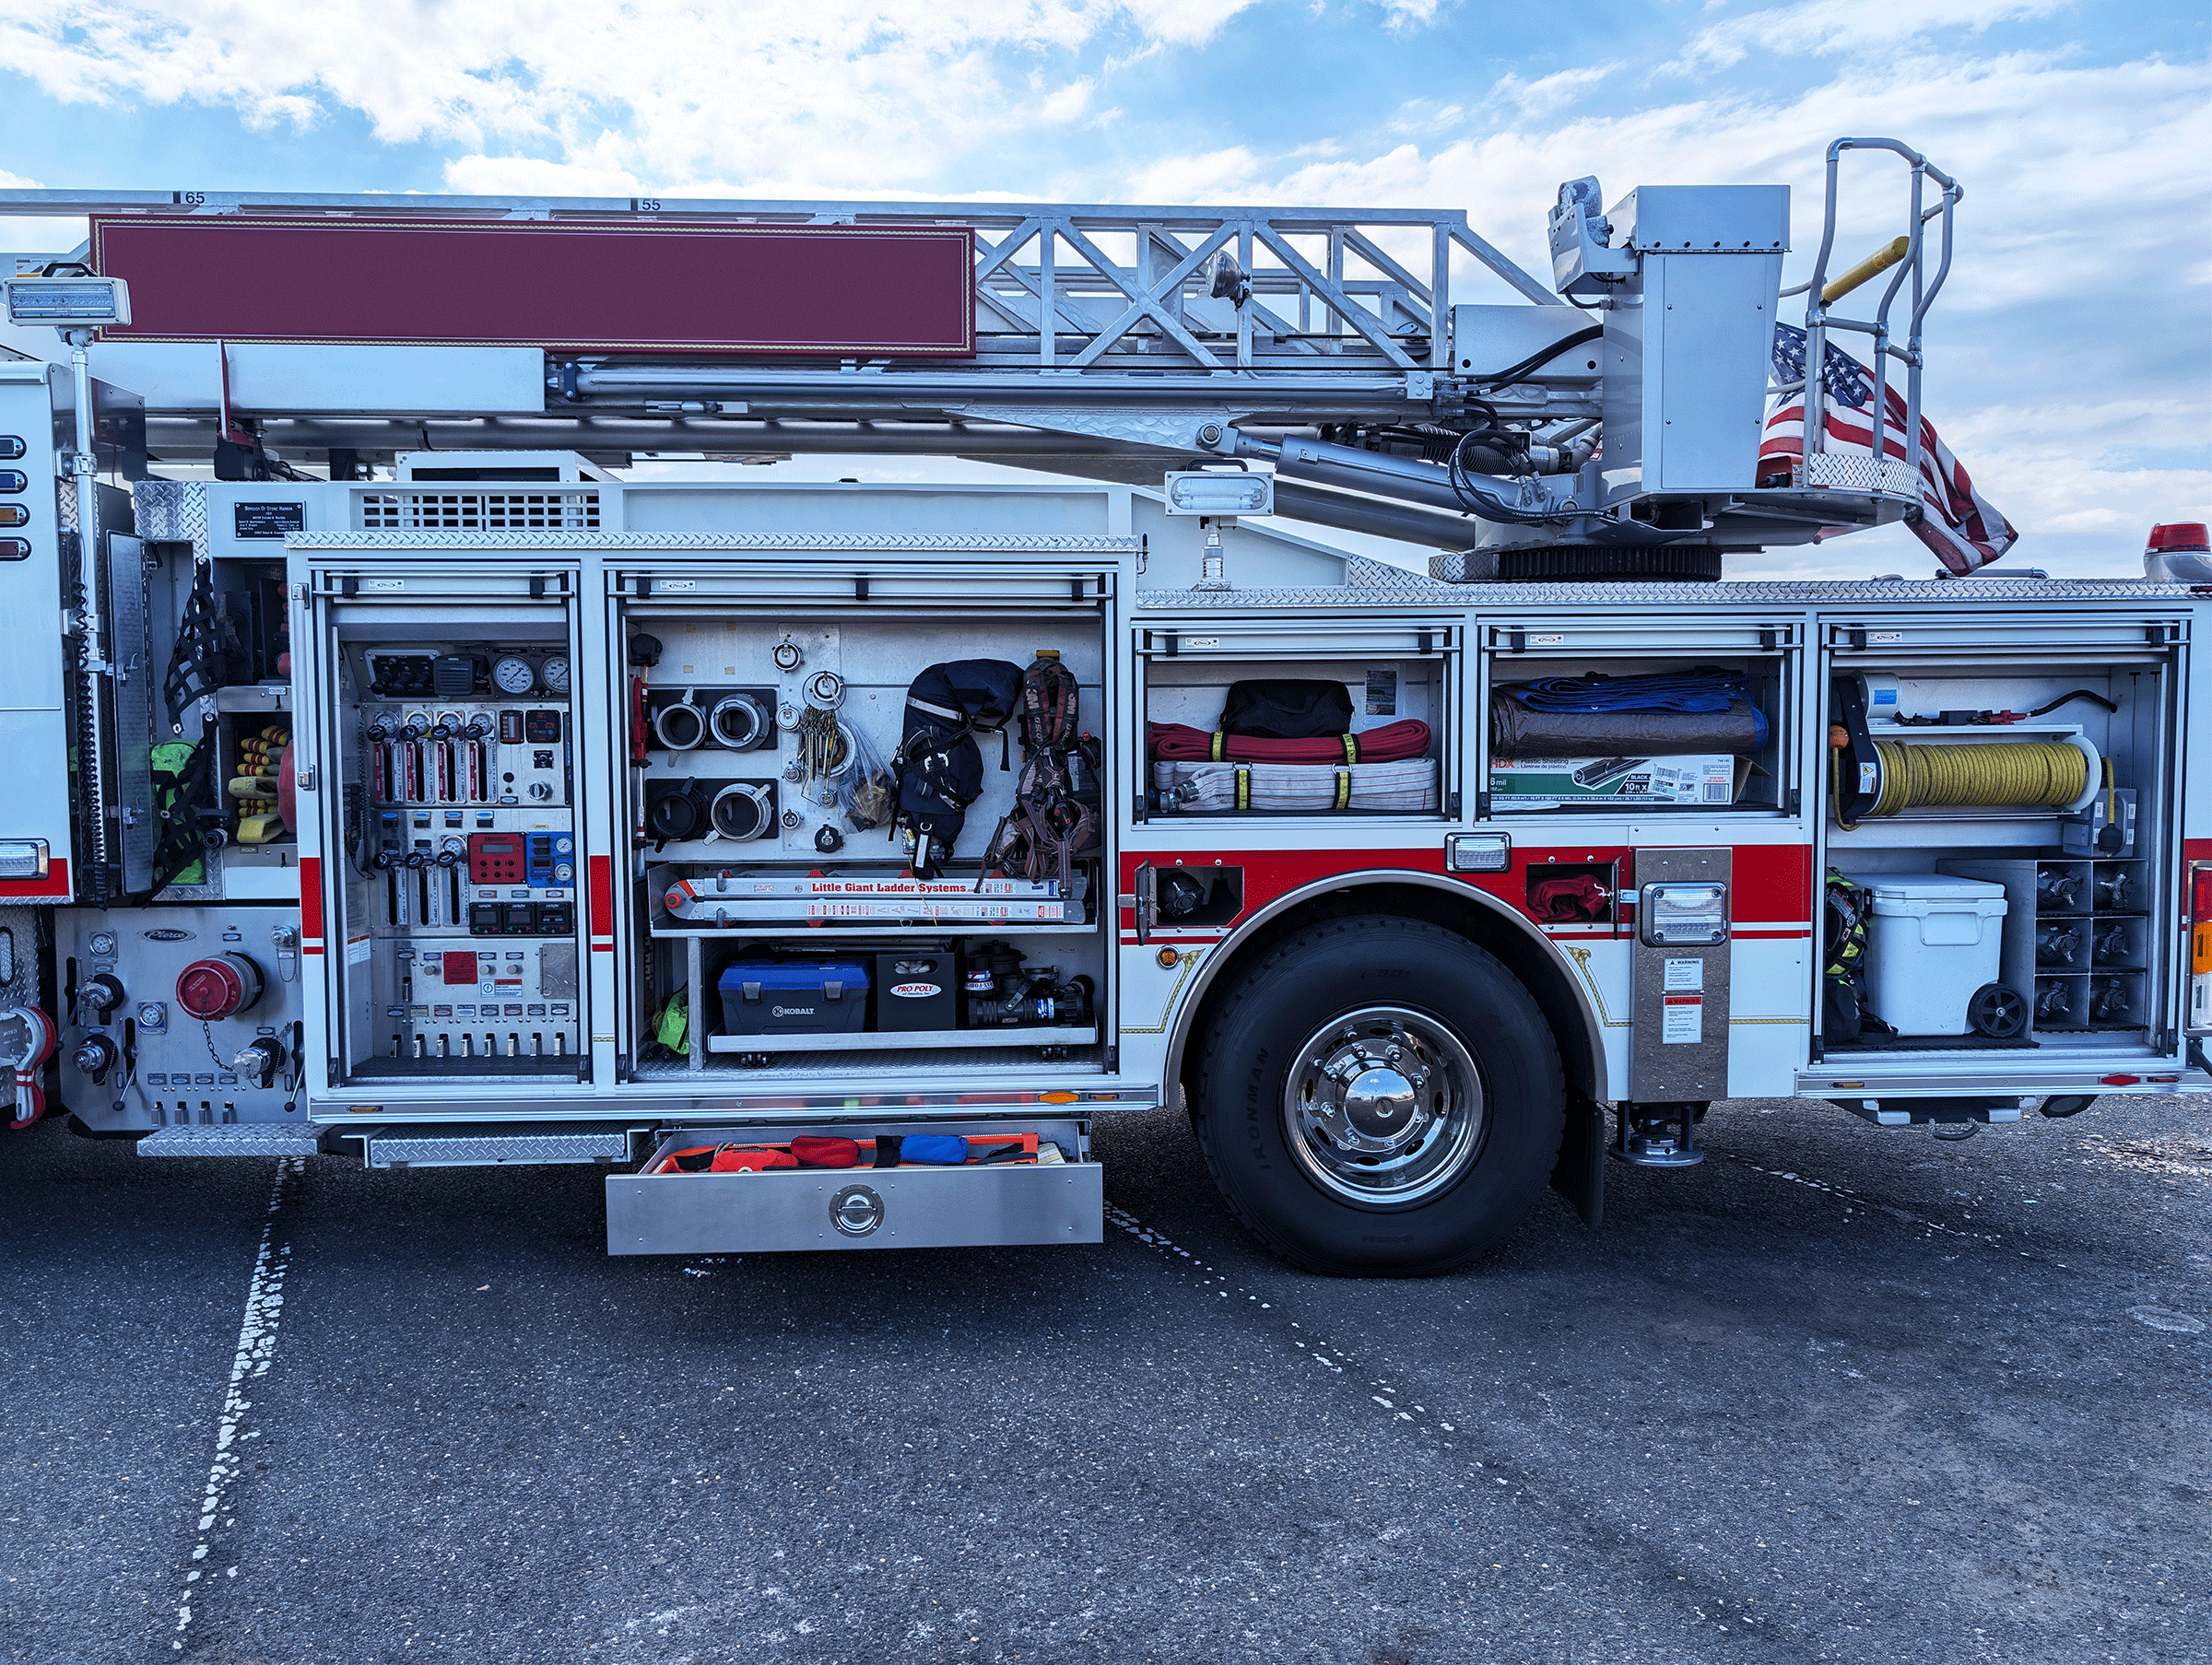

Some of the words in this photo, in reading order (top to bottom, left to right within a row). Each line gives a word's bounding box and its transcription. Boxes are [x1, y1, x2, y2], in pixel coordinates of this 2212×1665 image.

[186, 192, 205, 203] 65
[641, 199, 660, 210] 55
[1026, 688, 1040, 709] 3M
[1067, 693, 1077, 714] 3M
[1490, 758, 1515, 768] HDX
[812, 883, 841, 892] Little
[844, 883, 874, 892] Giant
[877, 883, 915, 892] Ladder
[1246, 1047, 1272, 1169] IRONMAN
